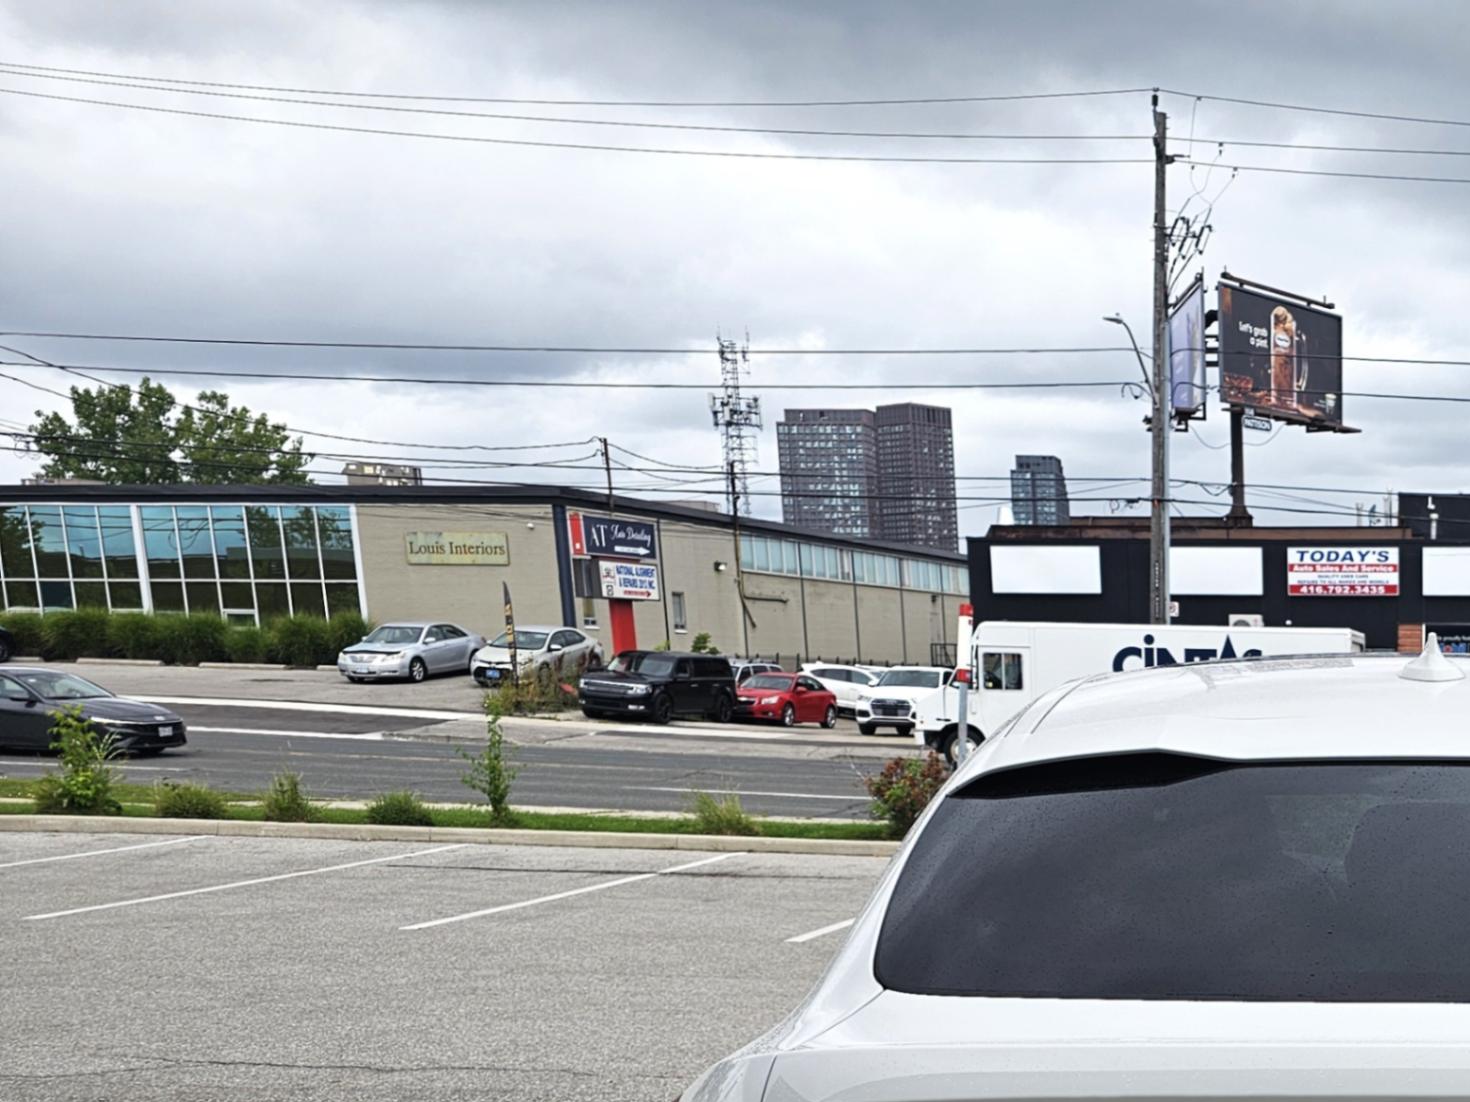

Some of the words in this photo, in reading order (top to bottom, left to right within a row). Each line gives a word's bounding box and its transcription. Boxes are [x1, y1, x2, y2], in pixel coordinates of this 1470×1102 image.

[591, 524, 608, 547] AT
[409, 541, 446, 555] Louis
[449, 541, 506, 555] Interiors
[1296, 550, 1390, 562] TODAY'S
